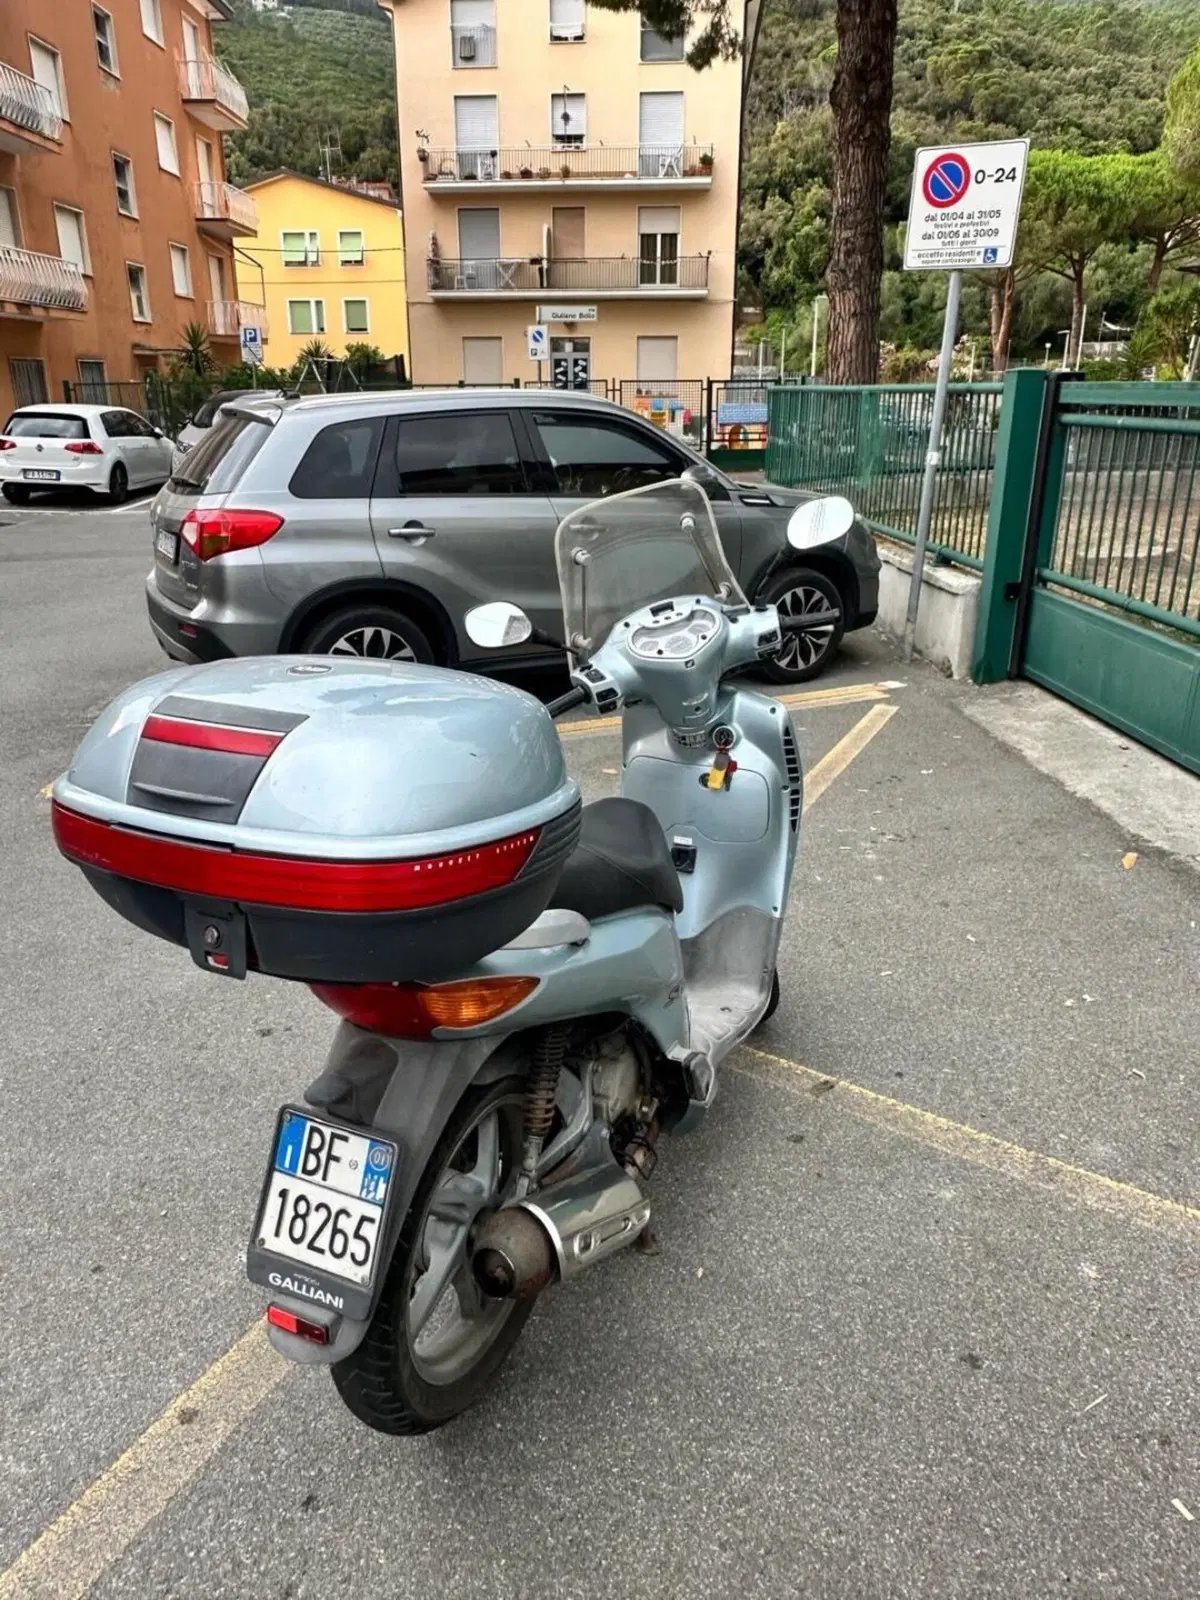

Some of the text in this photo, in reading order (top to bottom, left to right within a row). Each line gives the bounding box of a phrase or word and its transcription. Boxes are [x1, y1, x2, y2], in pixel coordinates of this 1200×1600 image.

[974, 167, 1017, 184] 0-24
[924, 209, 1001, 222] dal 01/04 al 31/05
[921, 228, 999, 240] dal 01/06 al 30/09
[917, 250, 944, 259] eccetto
[945, 249, 976, 258] residenti
[246, 329, 255, 342] P
[301, 1125, 350, 1182] BF
[274, 1188, 376, 1267] 18265
[268, 1272, 344, 1309] GALLIANI
